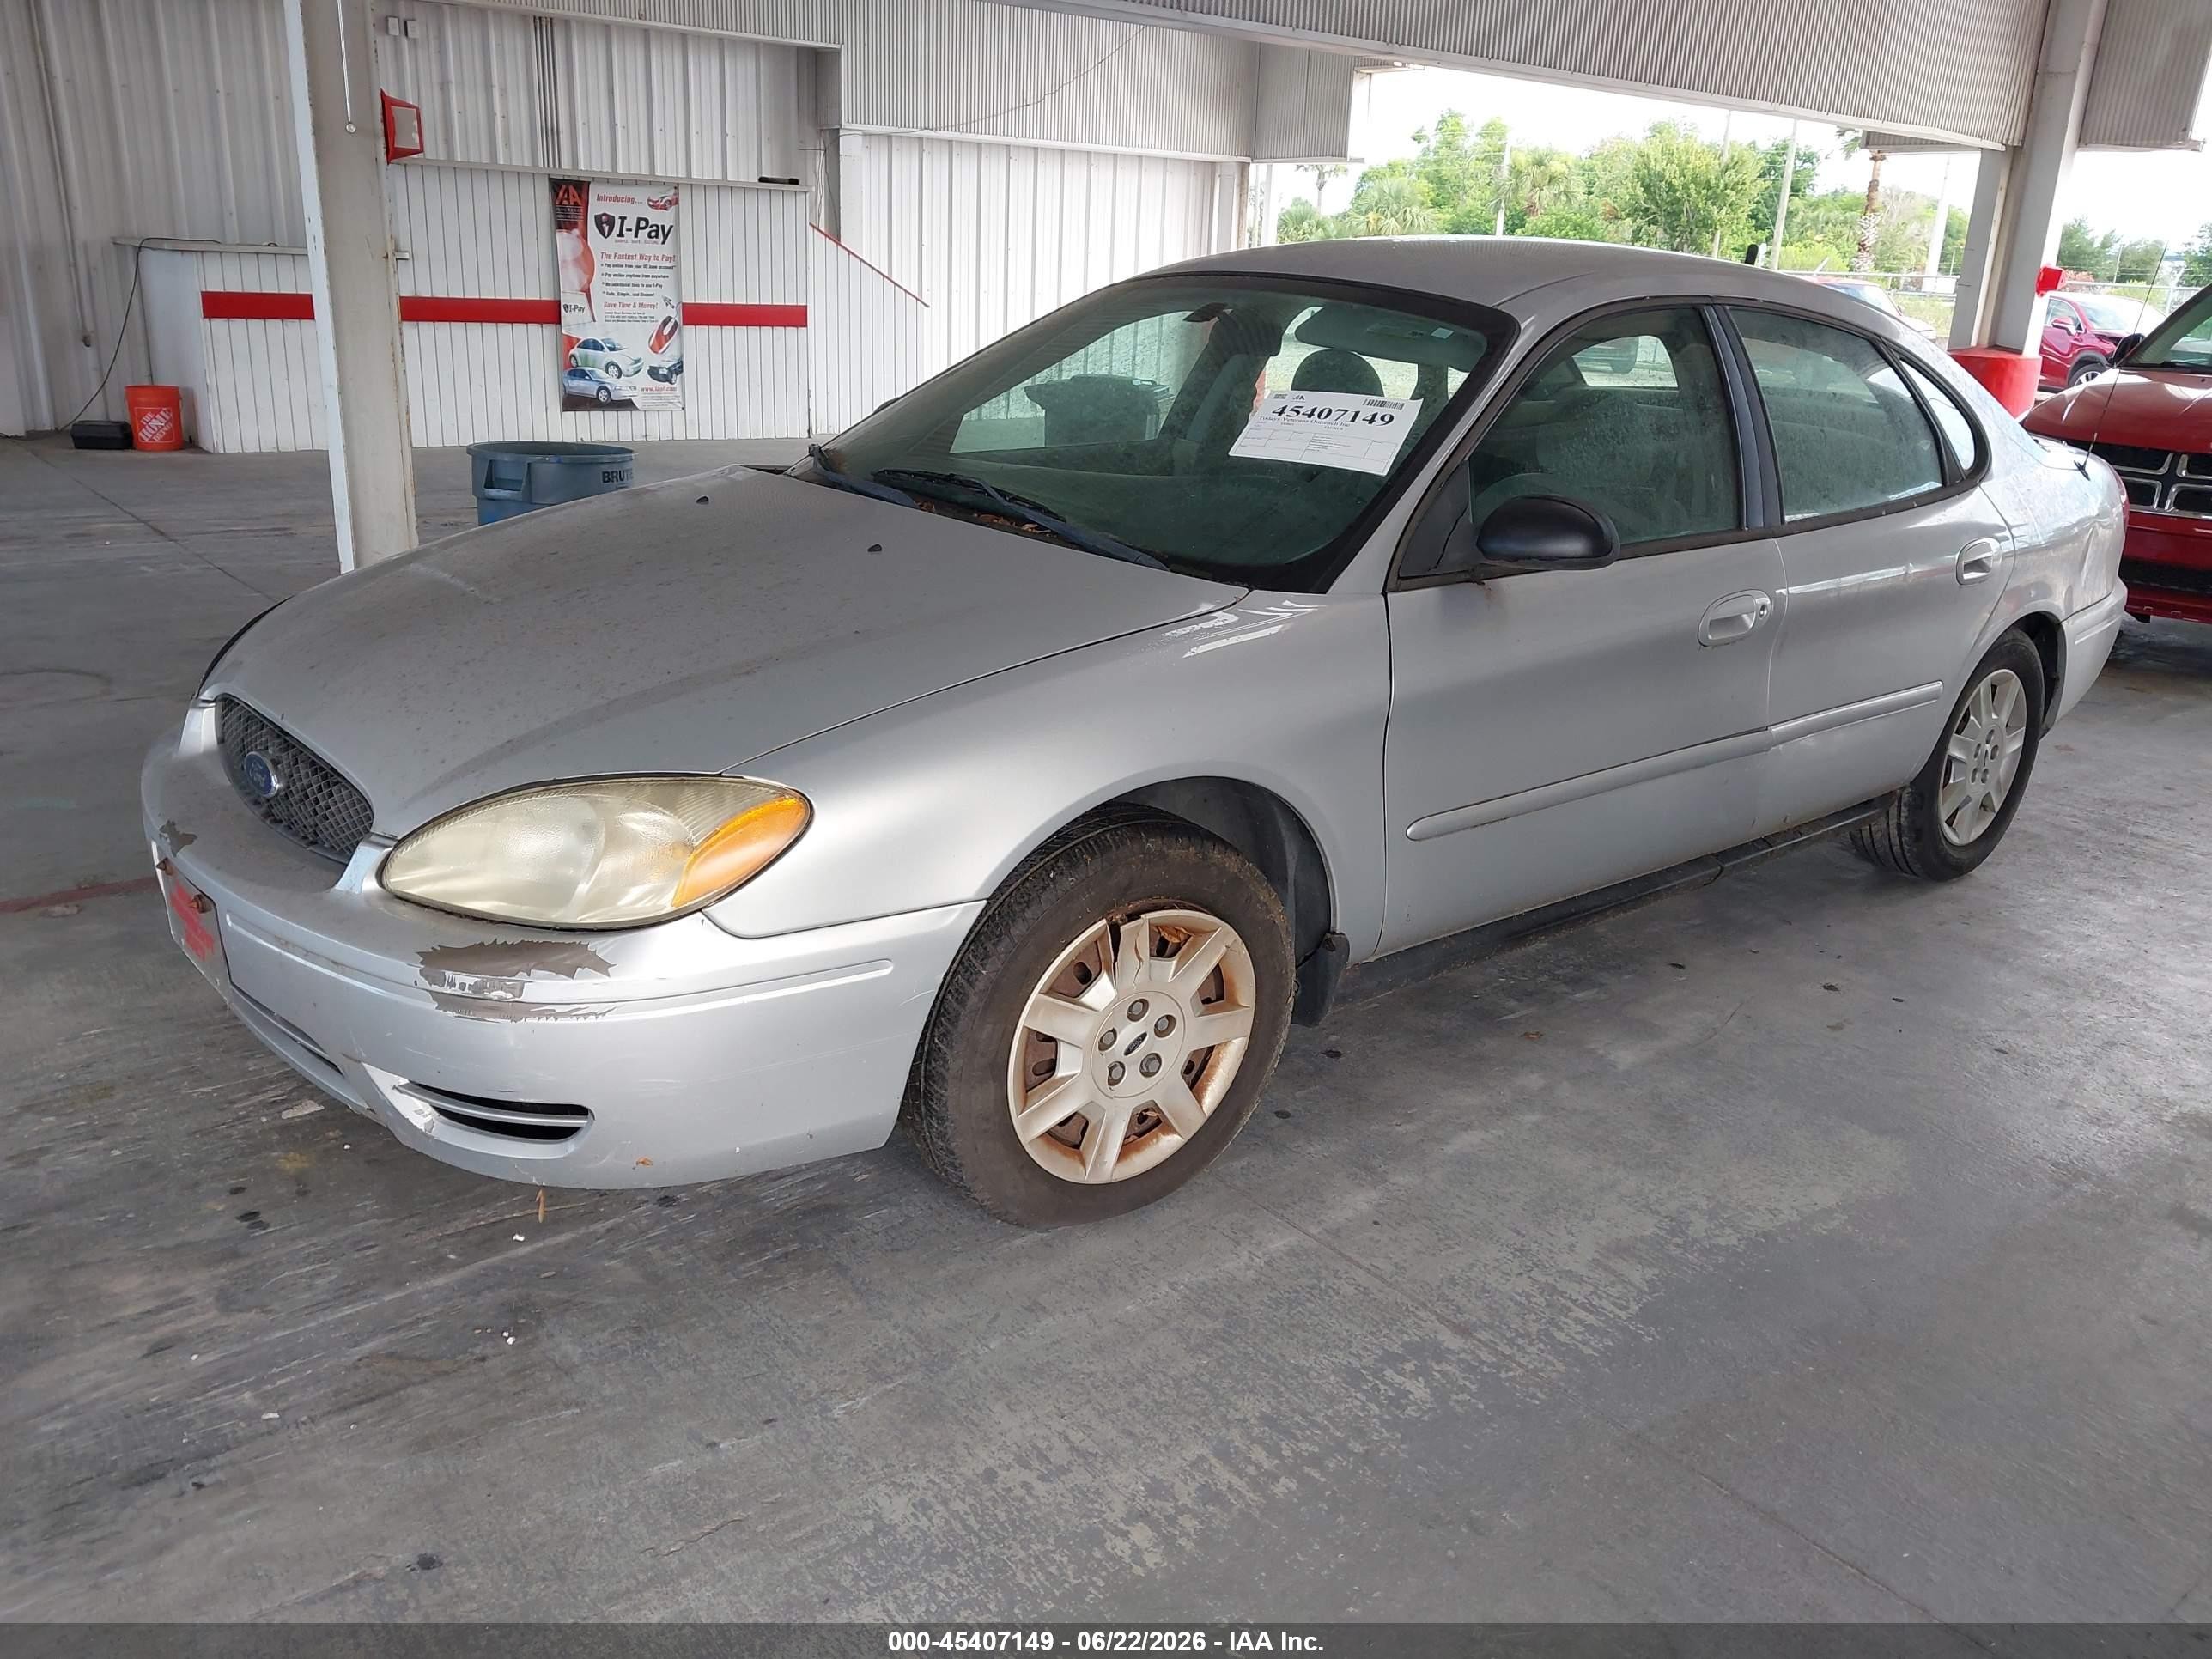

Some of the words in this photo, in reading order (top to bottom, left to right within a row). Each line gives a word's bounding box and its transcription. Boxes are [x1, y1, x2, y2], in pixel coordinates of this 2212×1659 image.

[617, 216, 674, 245] I-Pay
[601, 252, 612, 260] The
[613, 252, 637, 261] Fastest
[639, 253, 652, 262] Way
[660, 254, 676, 263] Pay!
[569, 304, 585, 313] I-Pay
[139, 408, 172, 441] HOME
[1272, 404, 1395, 427] 45407149
